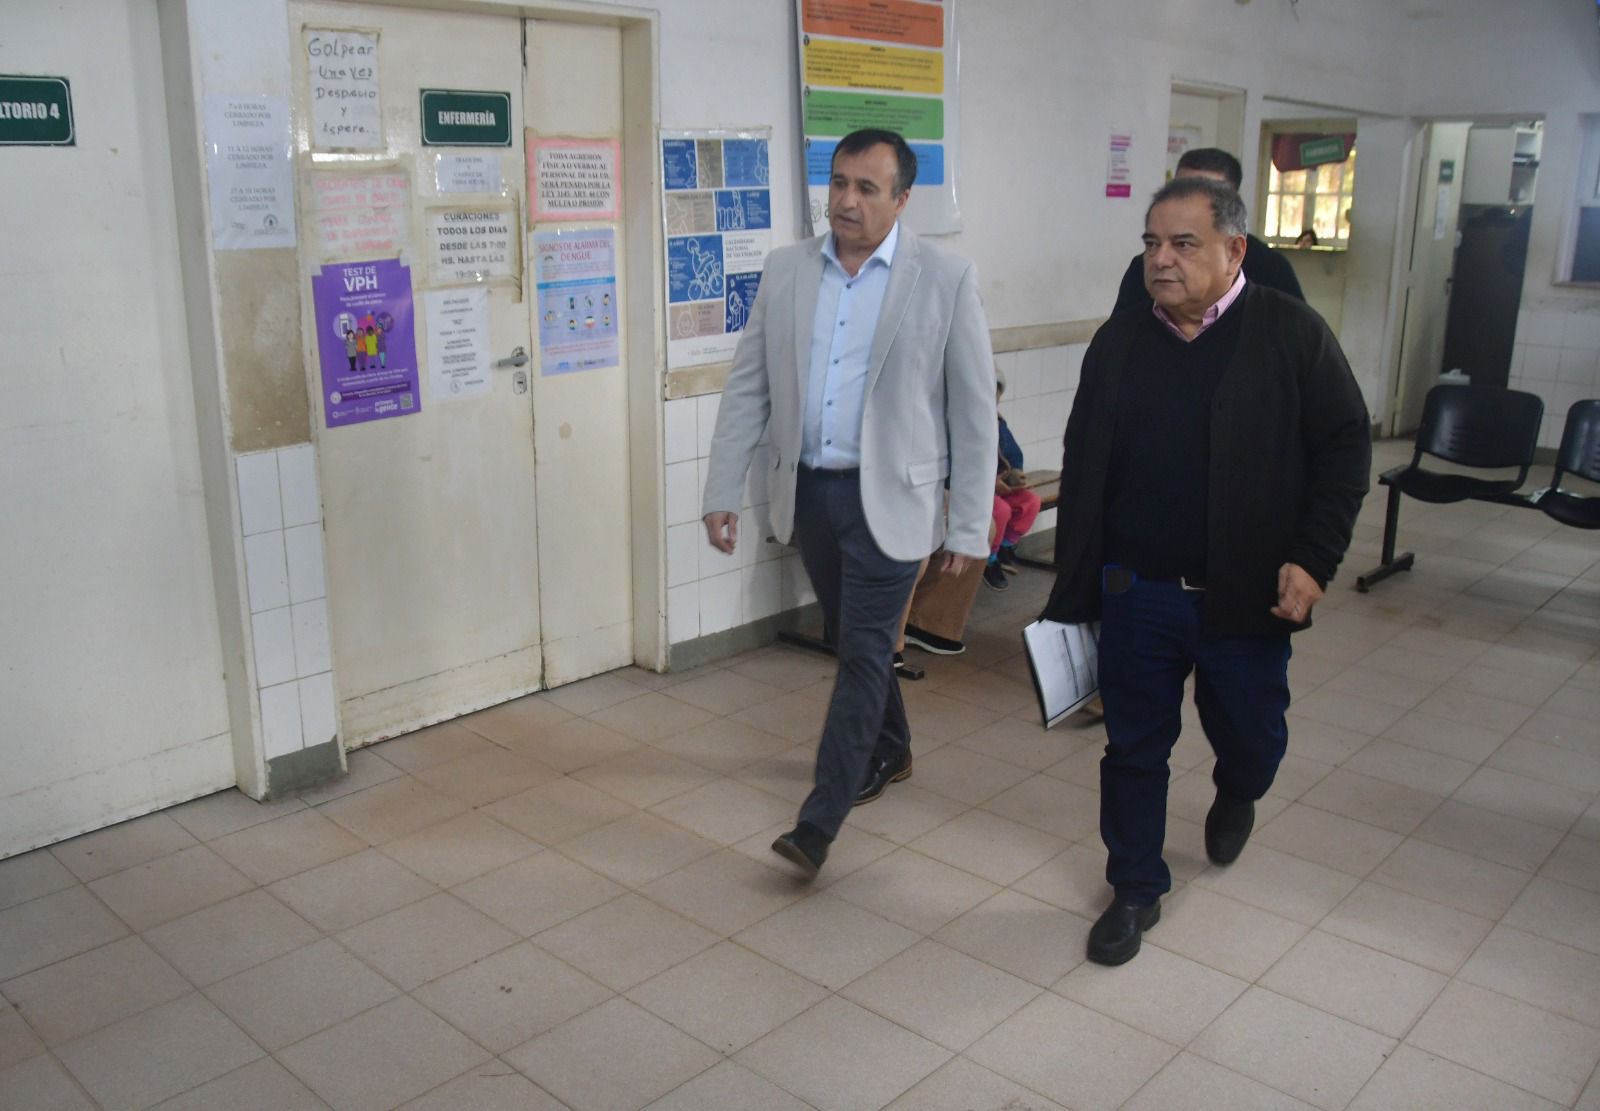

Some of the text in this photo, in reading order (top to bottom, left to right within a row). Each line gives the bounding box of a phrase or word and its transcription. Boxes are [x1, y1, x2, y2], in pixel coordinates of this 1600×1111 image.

[49, 102, 60, 120] 4
[438, 111, 496, 126] ENFERMERÍA
[541, 171, 577, 180] PERSONAL
[560, 181, 587, 190] PENADA
[542, 190, 555, 199] LEY
[548, 199, 571, 209] MULTA
[443, 211, 500, 221] CURACIONES
[437, 225, 508, 236] TODOS LOS DIAS
[440, 241, 468, 251] DESDE
[470, 241, 487, 250] LAS
[538, 242, 563, 253] SIGNOS
[564, 241, 573, 251] DE
[574, 240, 599, 251] ALARMA
[457, 255, 488, 264] HASTA
[560, 250, 592, 262] DENGUE
[343, 265, 377, 277] TEST DE
[343, 275, 379, 293] VPH
